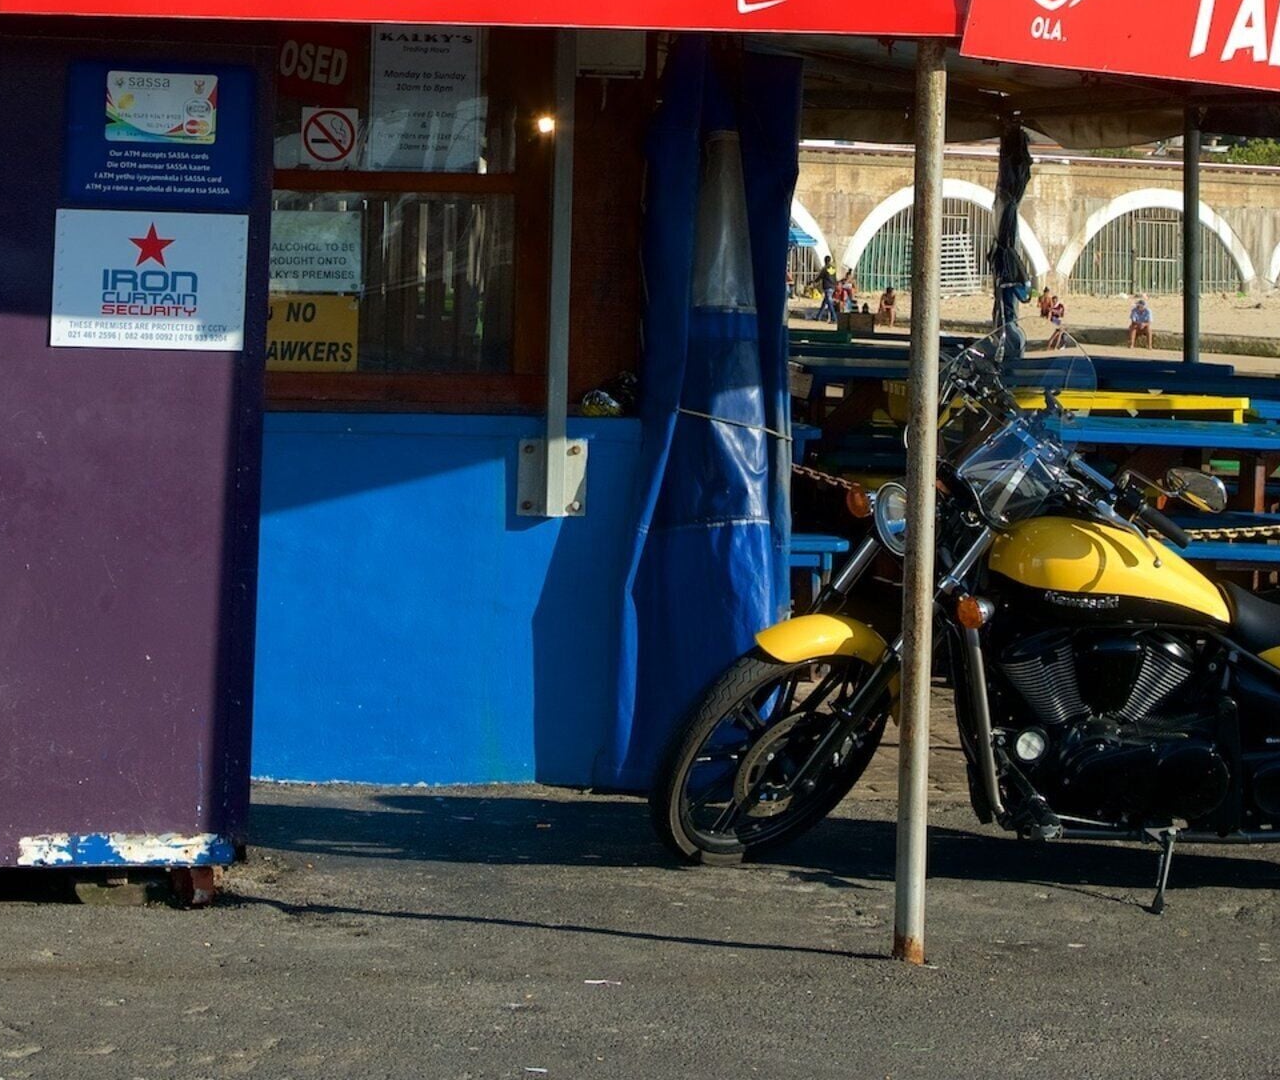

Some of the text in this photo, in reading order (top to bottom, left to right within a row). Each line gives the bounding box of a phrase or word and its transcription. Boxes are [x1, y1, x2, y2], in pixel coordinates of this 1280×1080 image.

[1031, 16, 1062, 40] OLA
[380, 32, 473, 44] KALKY'S
[384, 69, 468, 81] Monday to Sunday
[128, 76, 170, 89] sassa
[423, 84, 433, 92] to
[271, 242, 355, 252] ALCOHOL TO BE
[317, 257, 347, 266] ONTO
[102, 268, 199, 292] IRON
[302, 270, 355, 280] PREMISES
[102, 291, 198, 305] CURTAIN
[101, 305, 198, 316] SECURITY
[286, 302, 317, 323] NO
[69, 321, 93, 329] THESE
[95, 321, 133, 329] PREMISES
[134, 322, 150, 330] ARE
[151, 322, 195, 331] PROTECTED
[207, 324, 228, 332] CCTV
[267, 341, 353, 363] AWKERS
